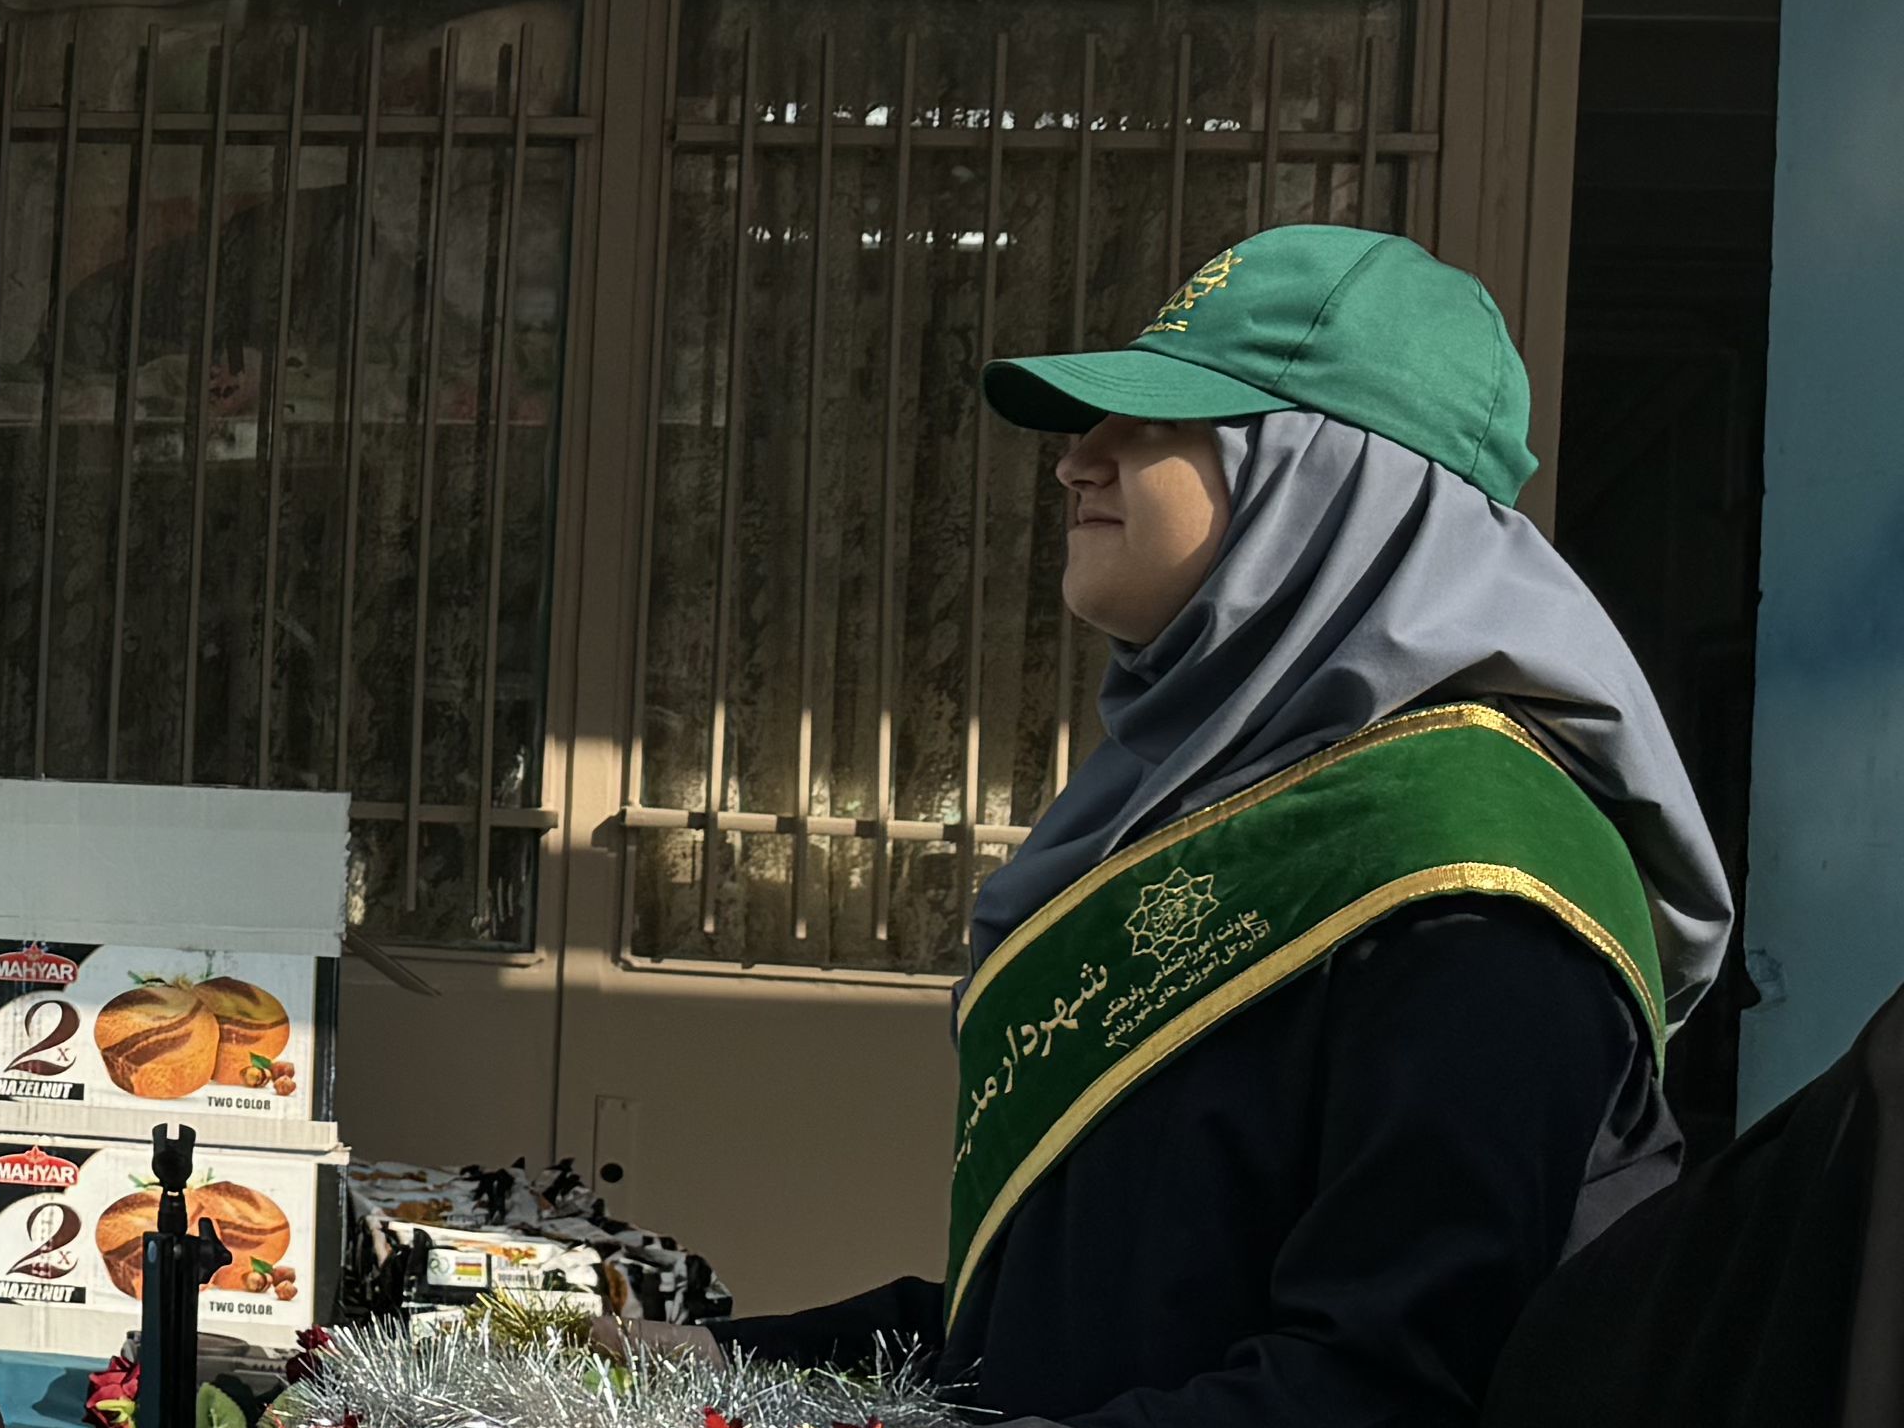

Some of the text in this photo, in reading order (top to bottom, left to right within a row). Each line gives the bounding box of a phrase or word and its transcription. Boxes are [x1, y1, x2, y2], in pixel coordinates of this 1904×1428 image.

[1002, 962, 1108, 1094] شهردار
[207, 1095, 233, 1110] TWO
[209, 1300, 273, 1316] TWO COLOR
